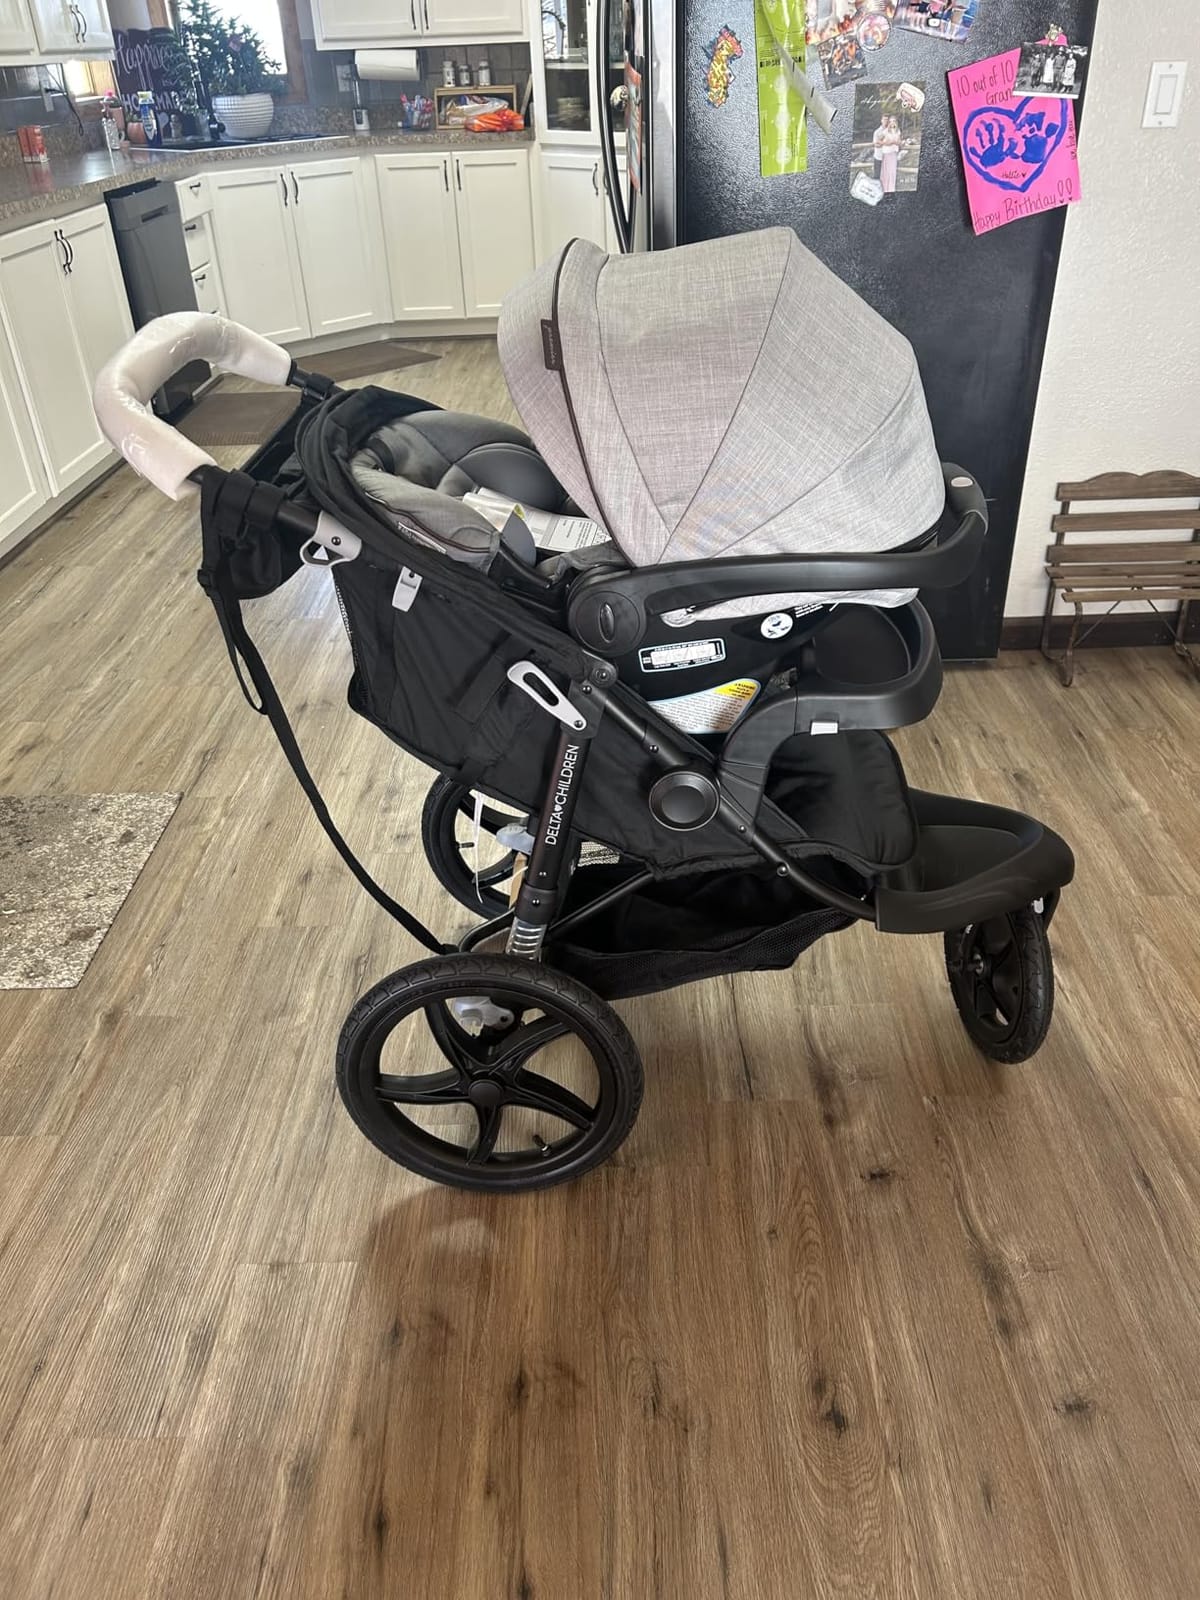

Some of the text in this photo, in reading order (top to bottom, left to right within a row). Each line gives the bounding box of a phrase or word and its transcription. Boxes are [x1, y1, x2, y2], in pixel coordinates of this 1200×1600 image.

[957, 60, 1014, 98] 10 out of 10
[974, 211, 1001, 229] Happy
[545, 744, 580, 845] DELTA CHILDREN
